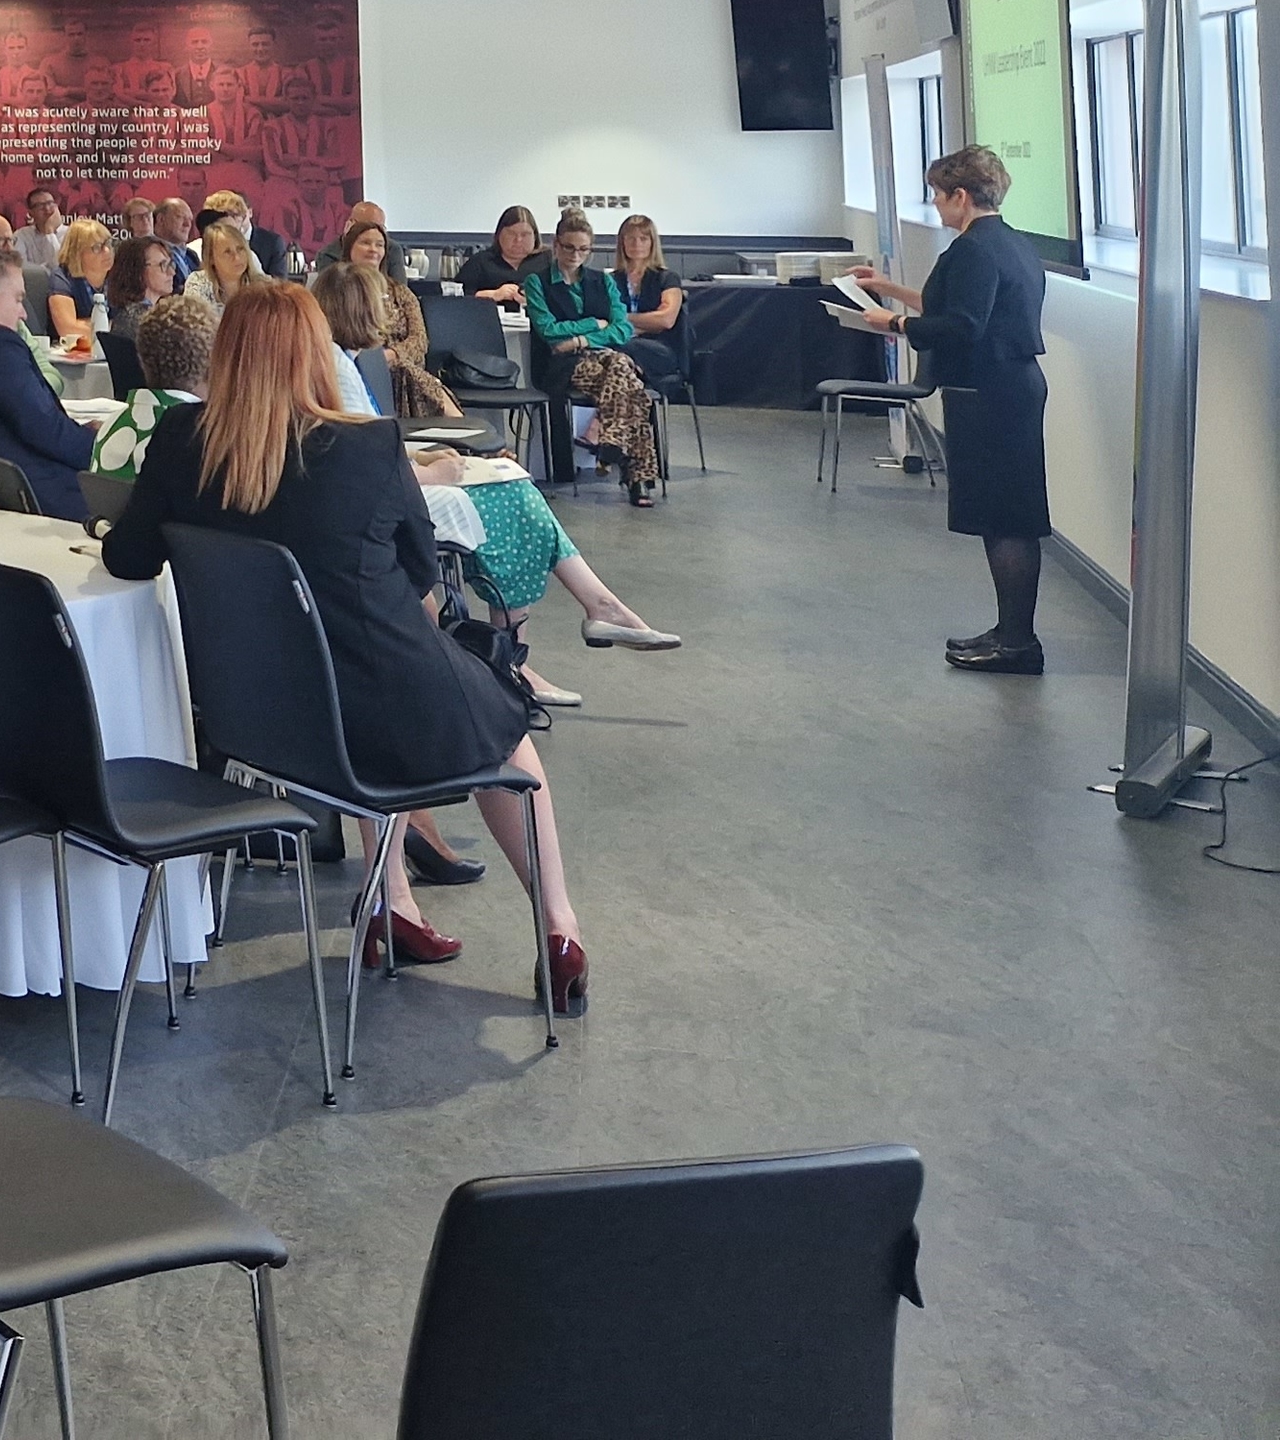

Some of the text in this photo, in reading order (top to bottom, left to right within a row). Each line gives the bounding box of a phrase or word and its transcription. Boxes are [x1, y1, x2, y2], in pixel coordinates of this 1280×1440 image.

[14, 108, 39, 118] was
[42, 106, 87, 120] acutely
[91, 108, 129, 118] aware
[133, 106, 159, 118] that
[163, 108, 177, 118] as
[180, 106, 207, 118] well
[1, 124, 14, 133] as
[18, 122, 96, 134] representing
[99, 124, 117, 134] my
[121, 123, 172, 134] country,
[183, 124, 209, 133] was
[71, 137, 91, 148] the
[95, 137, 137, 150] people
[141, 137, 154, 148] of
[158, 139, 176, 150] my
[180, 137, 222, 150] smoky
[0, 152, 34, 163] home
[38, 153, 71, 164] town,
[75, 152, 98, 163] and
[109, 154, 134, 163] was
[138, 152, 211, 163] determined
[36, 167, 57, 178] not
[60, 168, 72, 178] to
[76, 167, 92, 178] let
[96, 167, 129, 178] them
